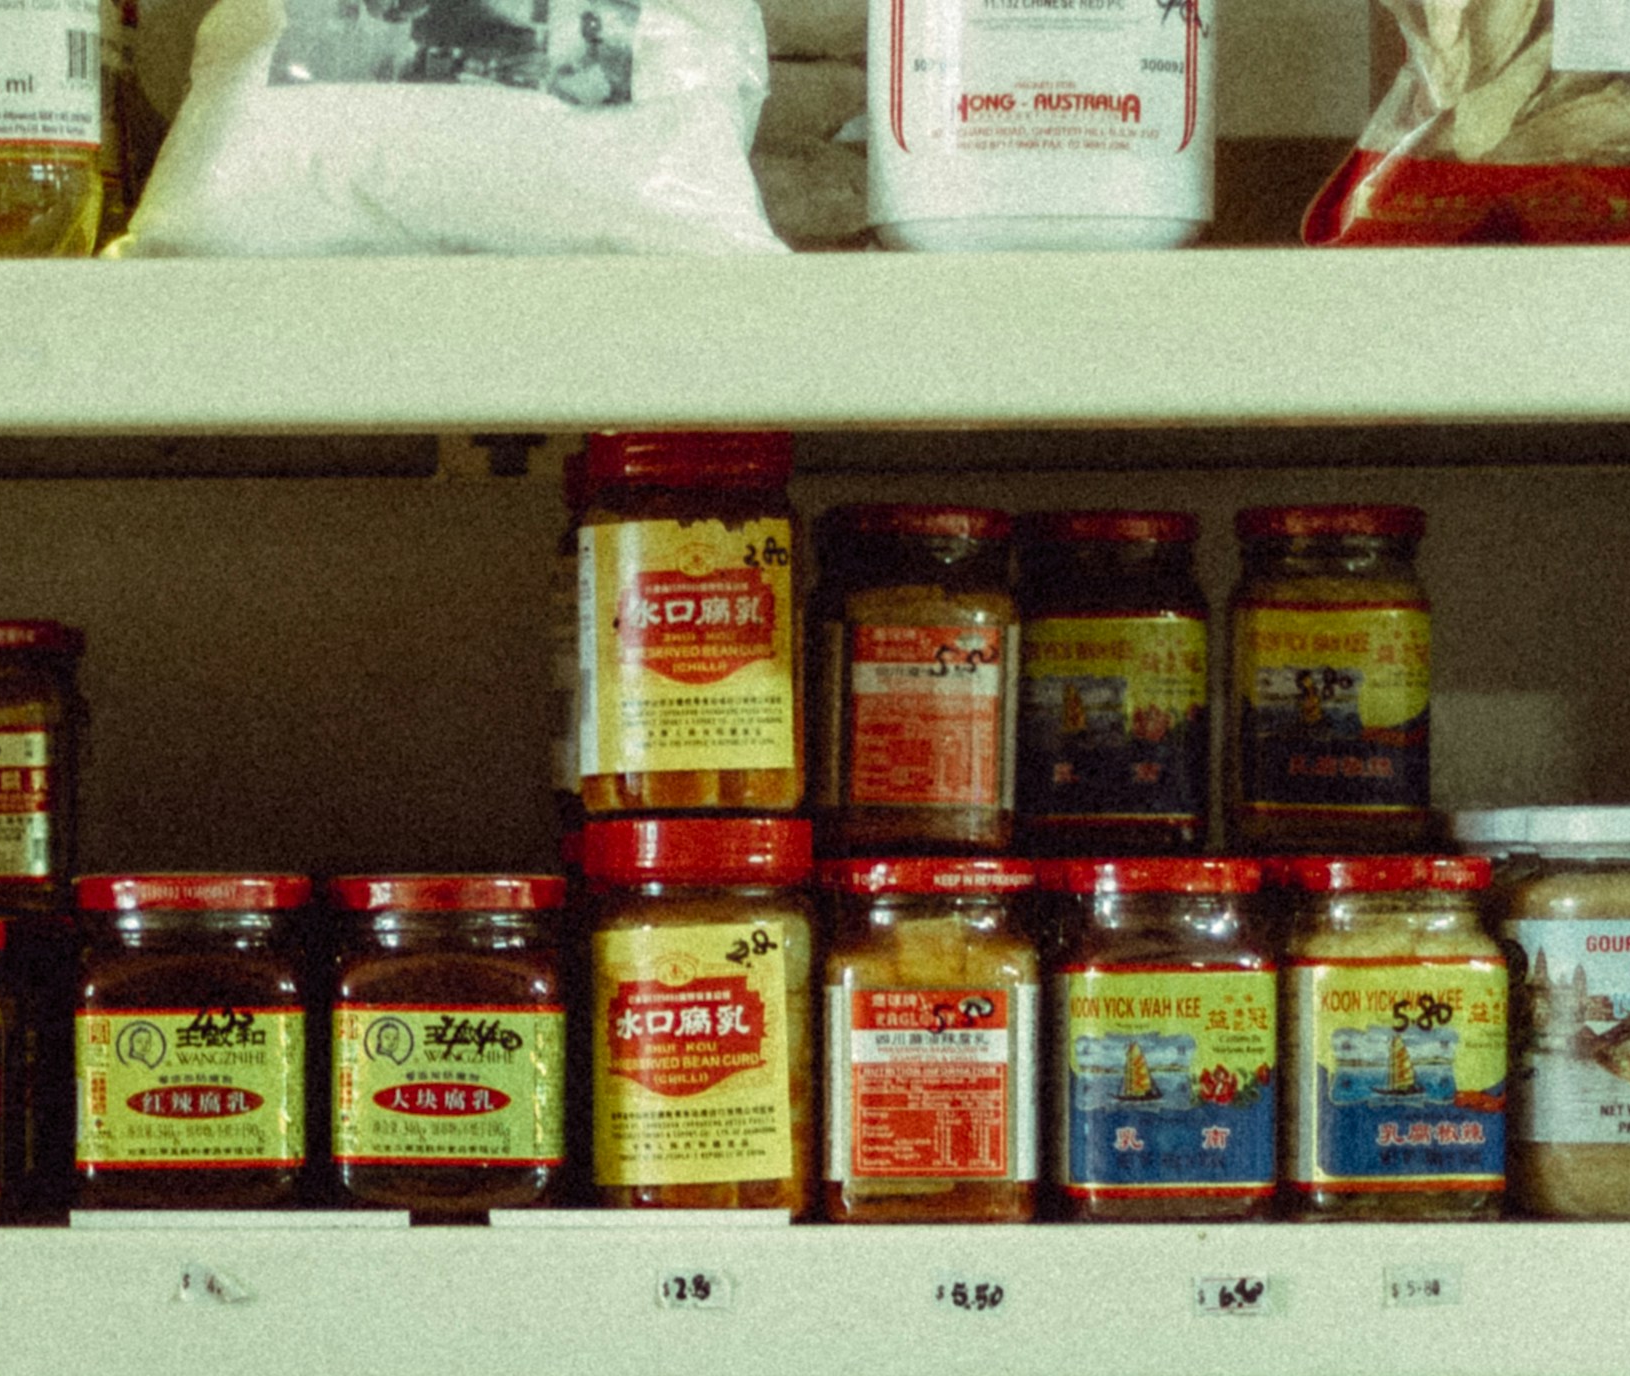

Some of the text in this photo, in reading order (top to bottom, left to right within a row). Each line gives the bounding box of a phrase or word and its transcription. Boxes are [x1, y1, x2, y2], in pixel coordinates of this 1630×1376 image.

[5, 74, 35, 94] ml
[1034, 93, 1142, 123] AUSTRALIA
[1103, 996, 1202, 1019] YICK WAH KEE
[1320, 990, 1362, 1013] KOON
[616, 1004, 751, 1040] 水口腐乳
[685, 1042, 718, 1053] KOU
[176, 1050, 267, 1067] WANGZHIHE
[682, 1052, 760, 1068] BEAN CURD
